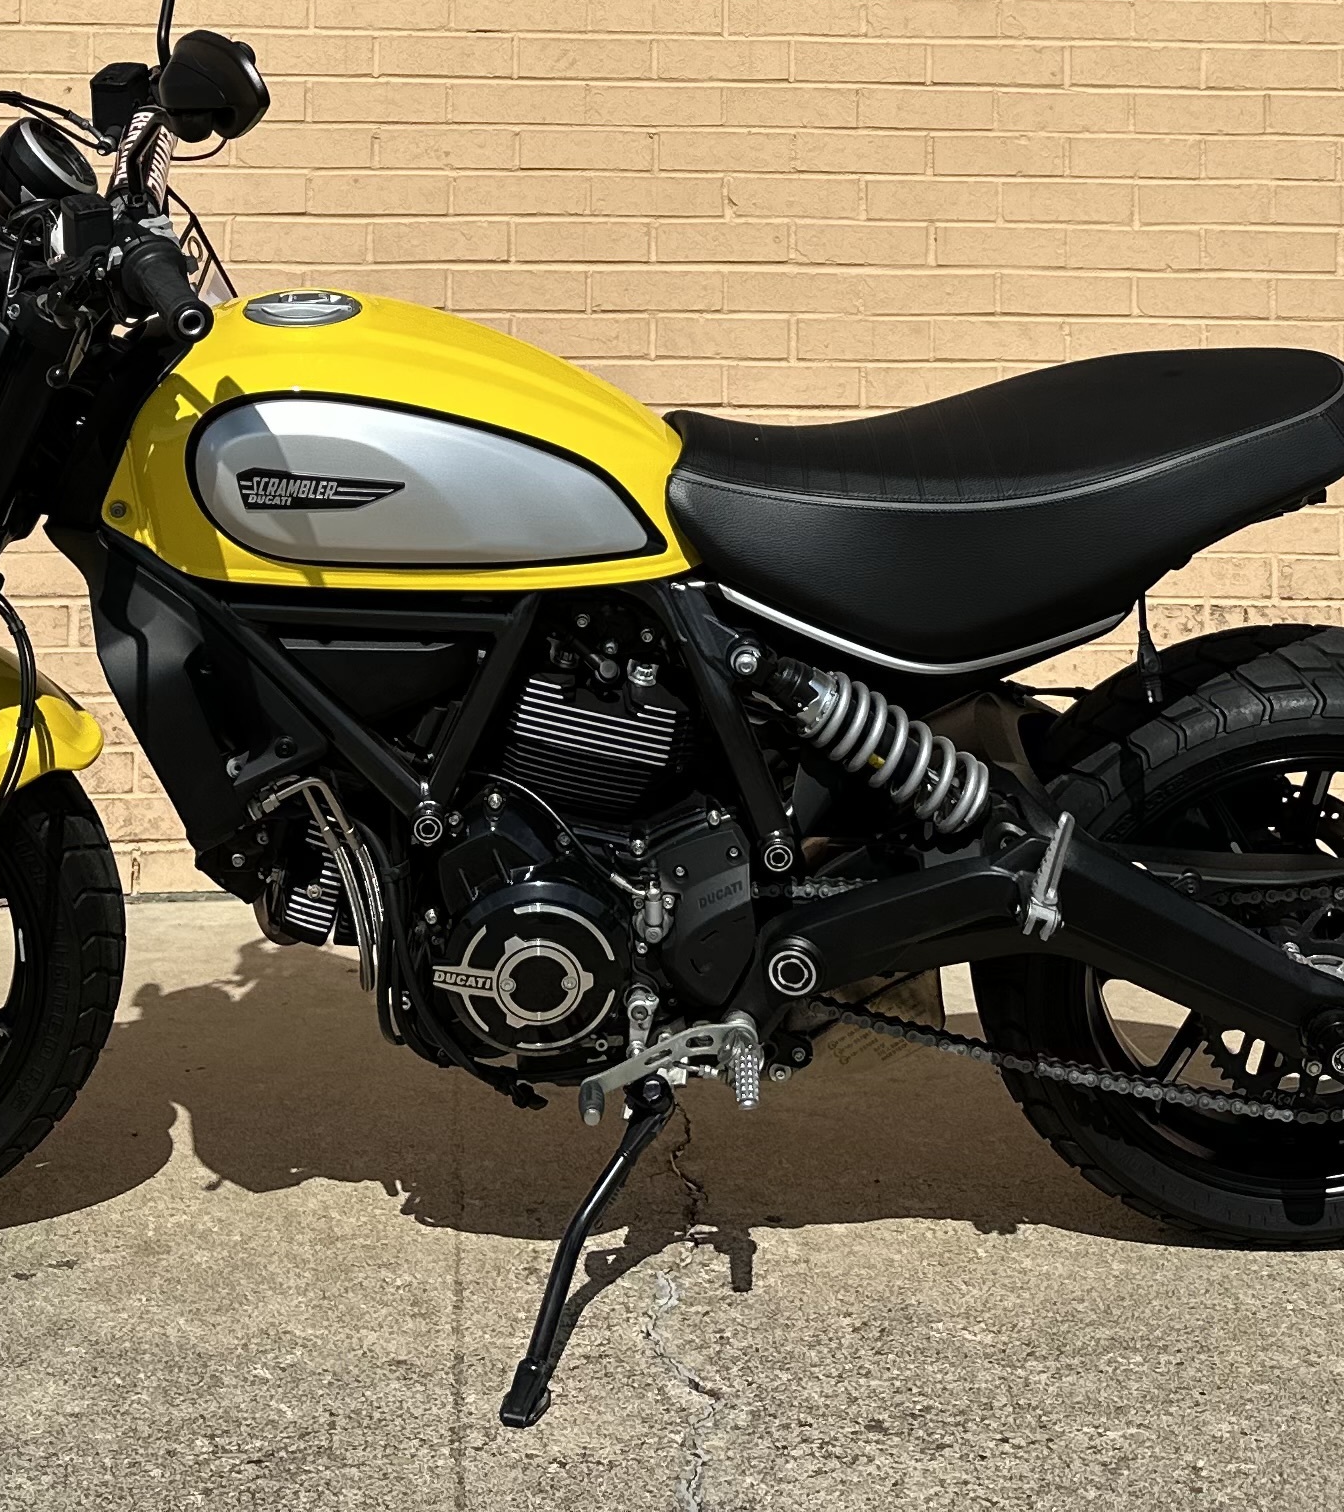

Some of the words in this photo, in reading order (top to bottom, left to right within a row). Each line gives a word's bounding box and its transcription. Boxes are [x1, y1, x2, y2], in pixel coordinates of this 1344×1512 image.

[251, 476, 338, 500] SCRAMBLER
[248, 494, 292, 506] DUCATI
[698, 879, 744, 909] DUCATI
[433, 970, 492, 989] DUCATI
